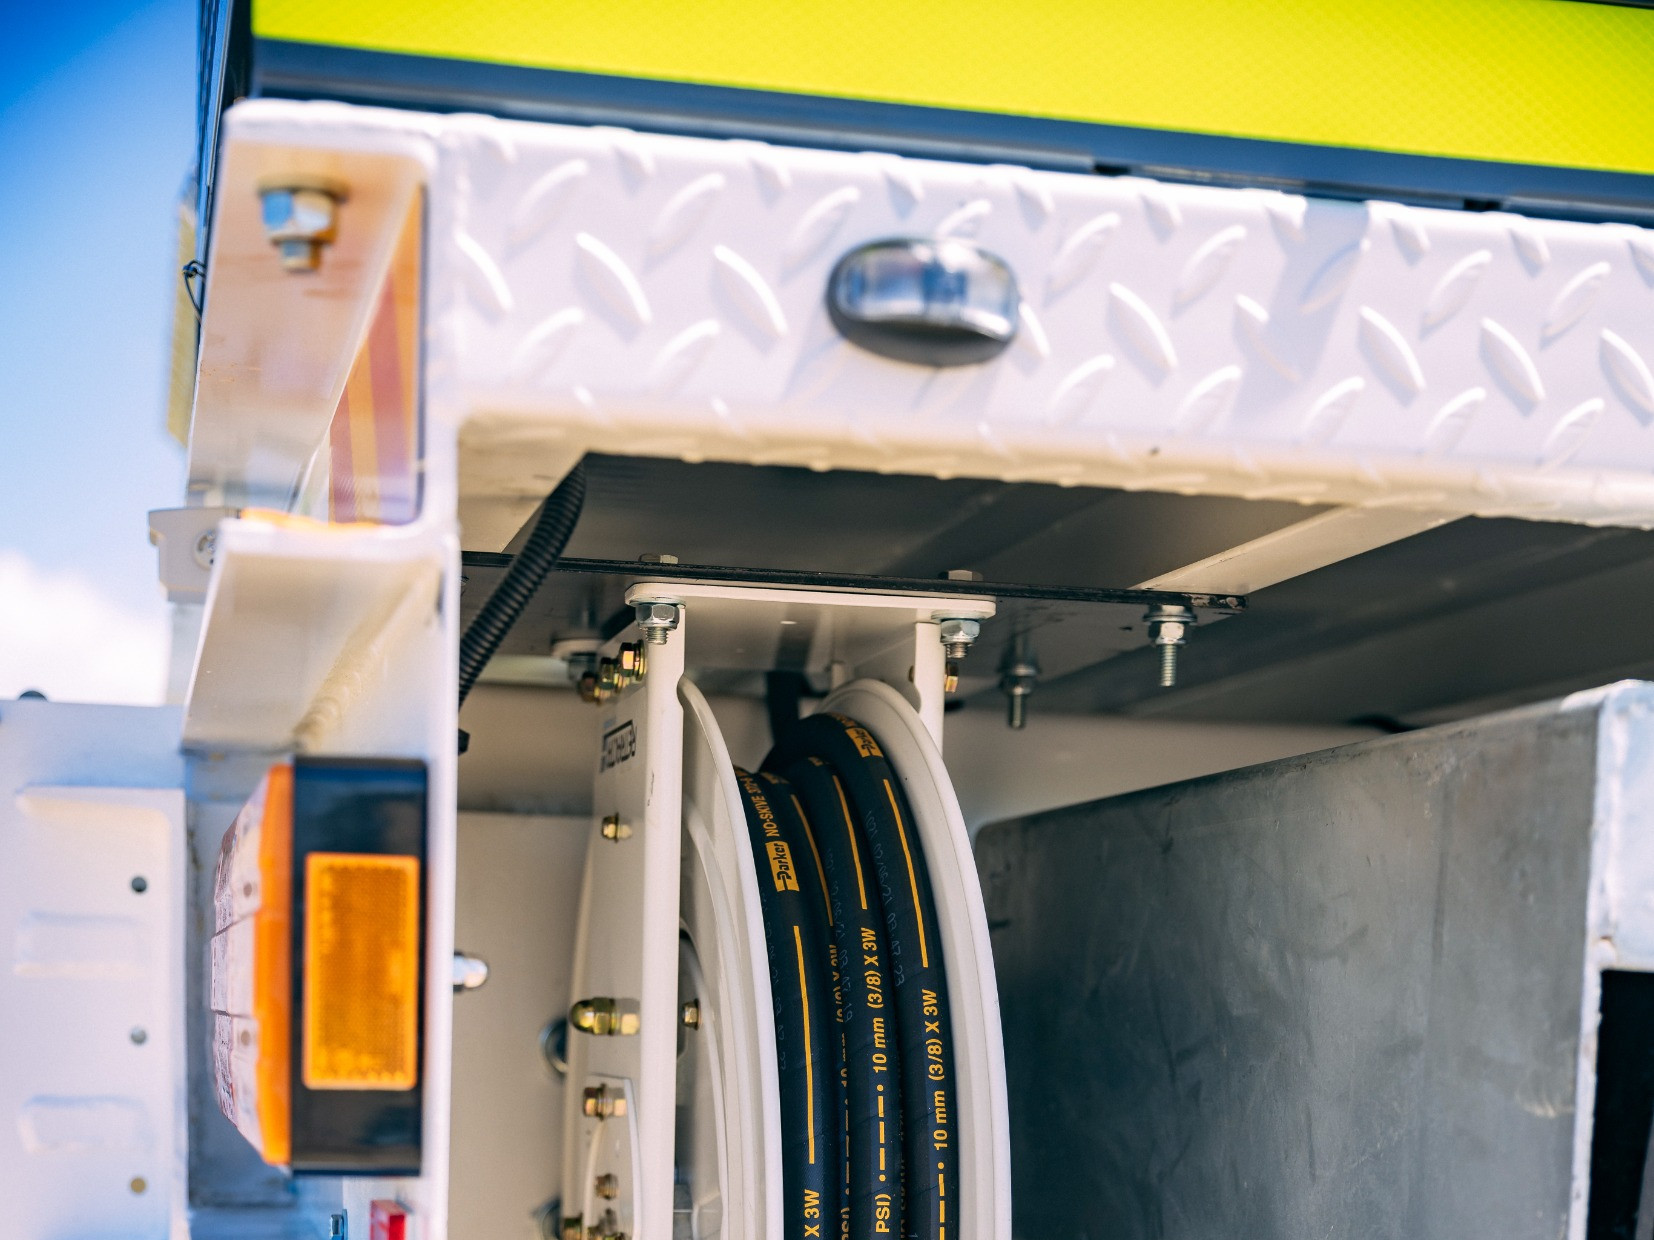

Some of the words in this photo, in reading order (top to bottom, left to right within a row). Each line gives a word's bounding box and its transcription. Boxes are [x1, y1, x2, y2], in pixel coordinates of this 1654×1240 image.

[751, 796, 780, 837] NO-SKIVE
[770, 842, 793, 890] Parker
[861, 927, 878, 951] 3W
[863, 954, 879, 967] X
[864, 970, 884, 1009] (3/8)
[922, 988, 938, 1016] 3W
[872, 1018, 886, 1049] mm
[924, 1021, 940, 1034] X
[872, 1053, 887, 1074] 10
[928, 1038, 945, 1081] (3/8)
[933, 1090, 947, 1124] mm
[933, 1130, 948, 1150] 10
[804, 1188, 820, 1219] 3W
[874, 1193, 891, 1233] PSI)
[804, 1224, 820, 1237] X
